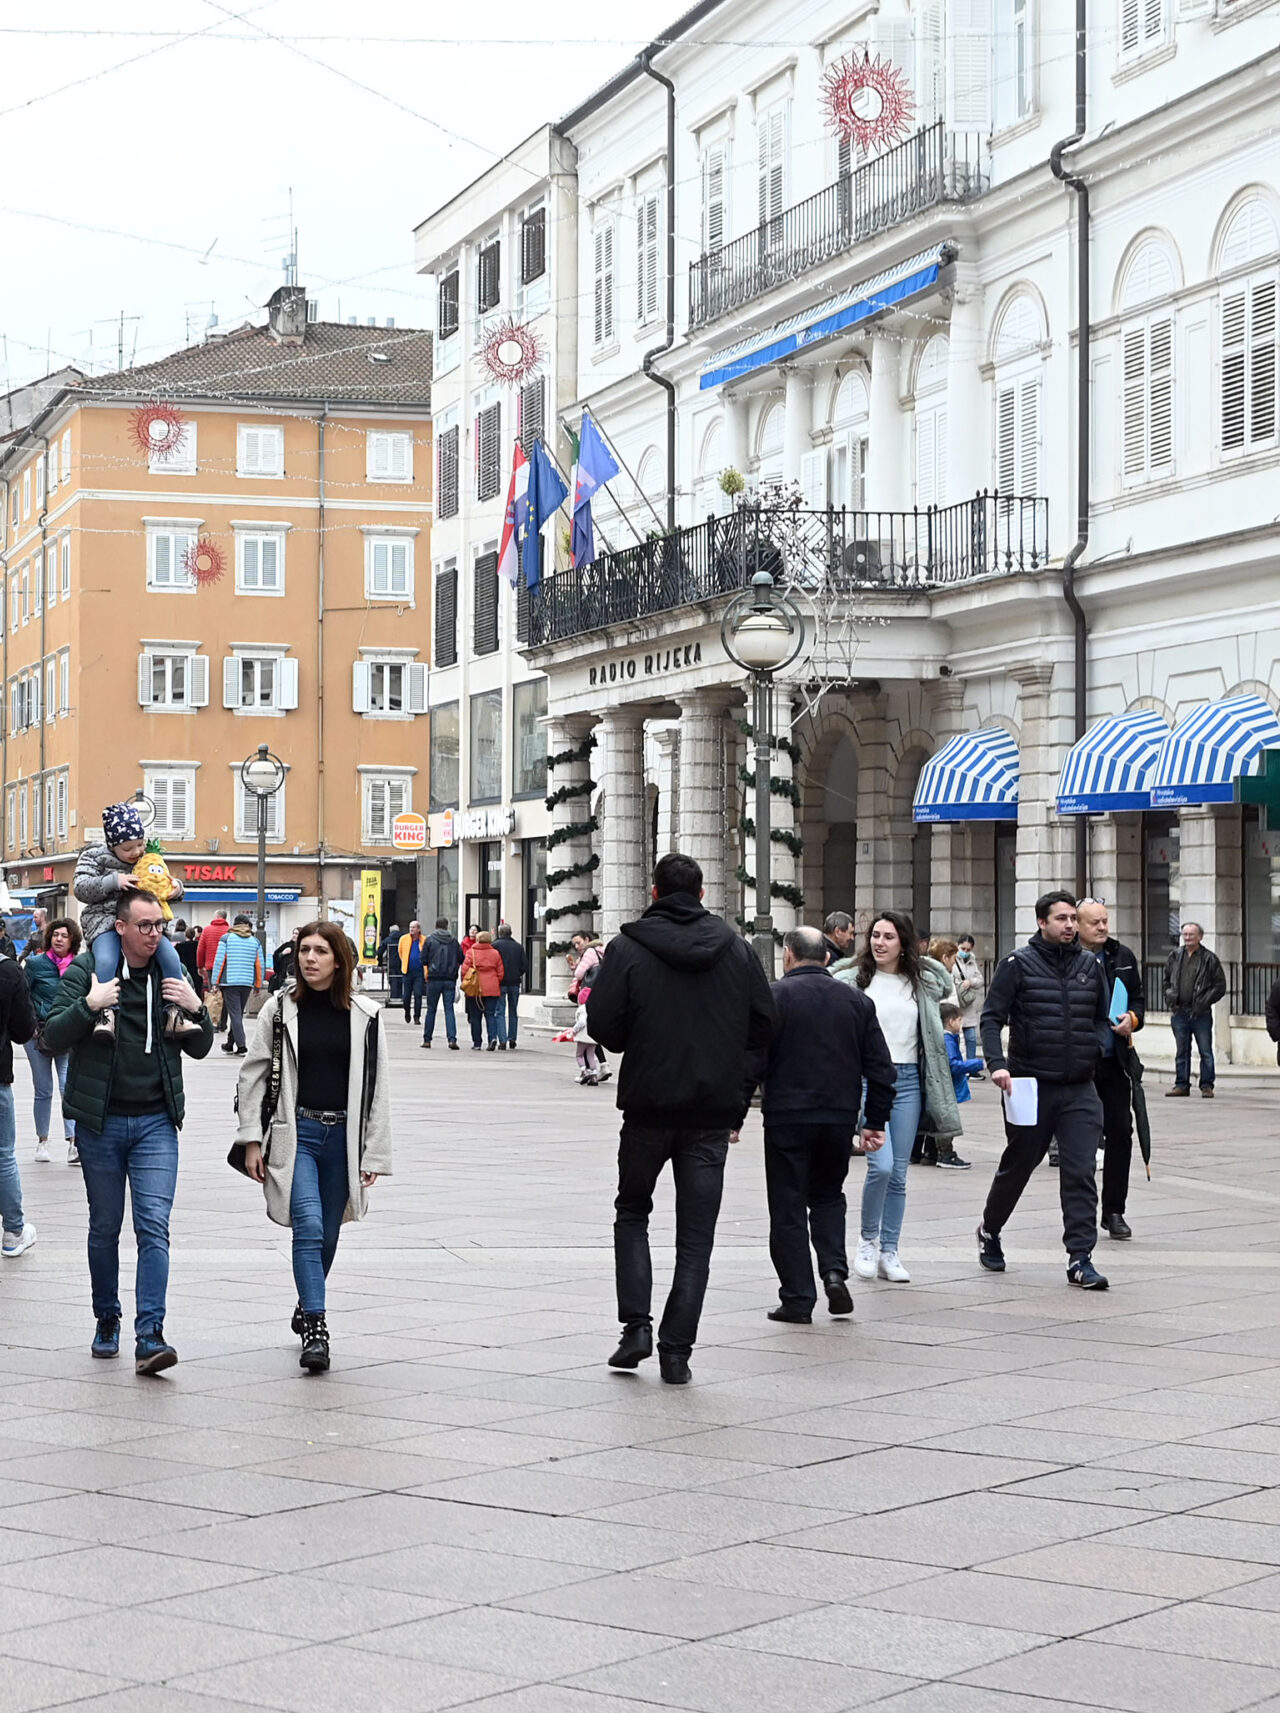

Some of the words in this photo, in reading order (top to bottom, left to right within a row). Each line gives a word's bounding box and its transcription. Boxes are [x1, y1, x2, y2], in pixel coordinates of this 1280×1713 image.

[589, 659, 636, 686] RADIO
[644, 642, 702, 675] RIJEKA
[394, 824, 424, 832] BURGER
[394, 831, 424, 841] KING
[184, 865, 238, 881] TISAK
